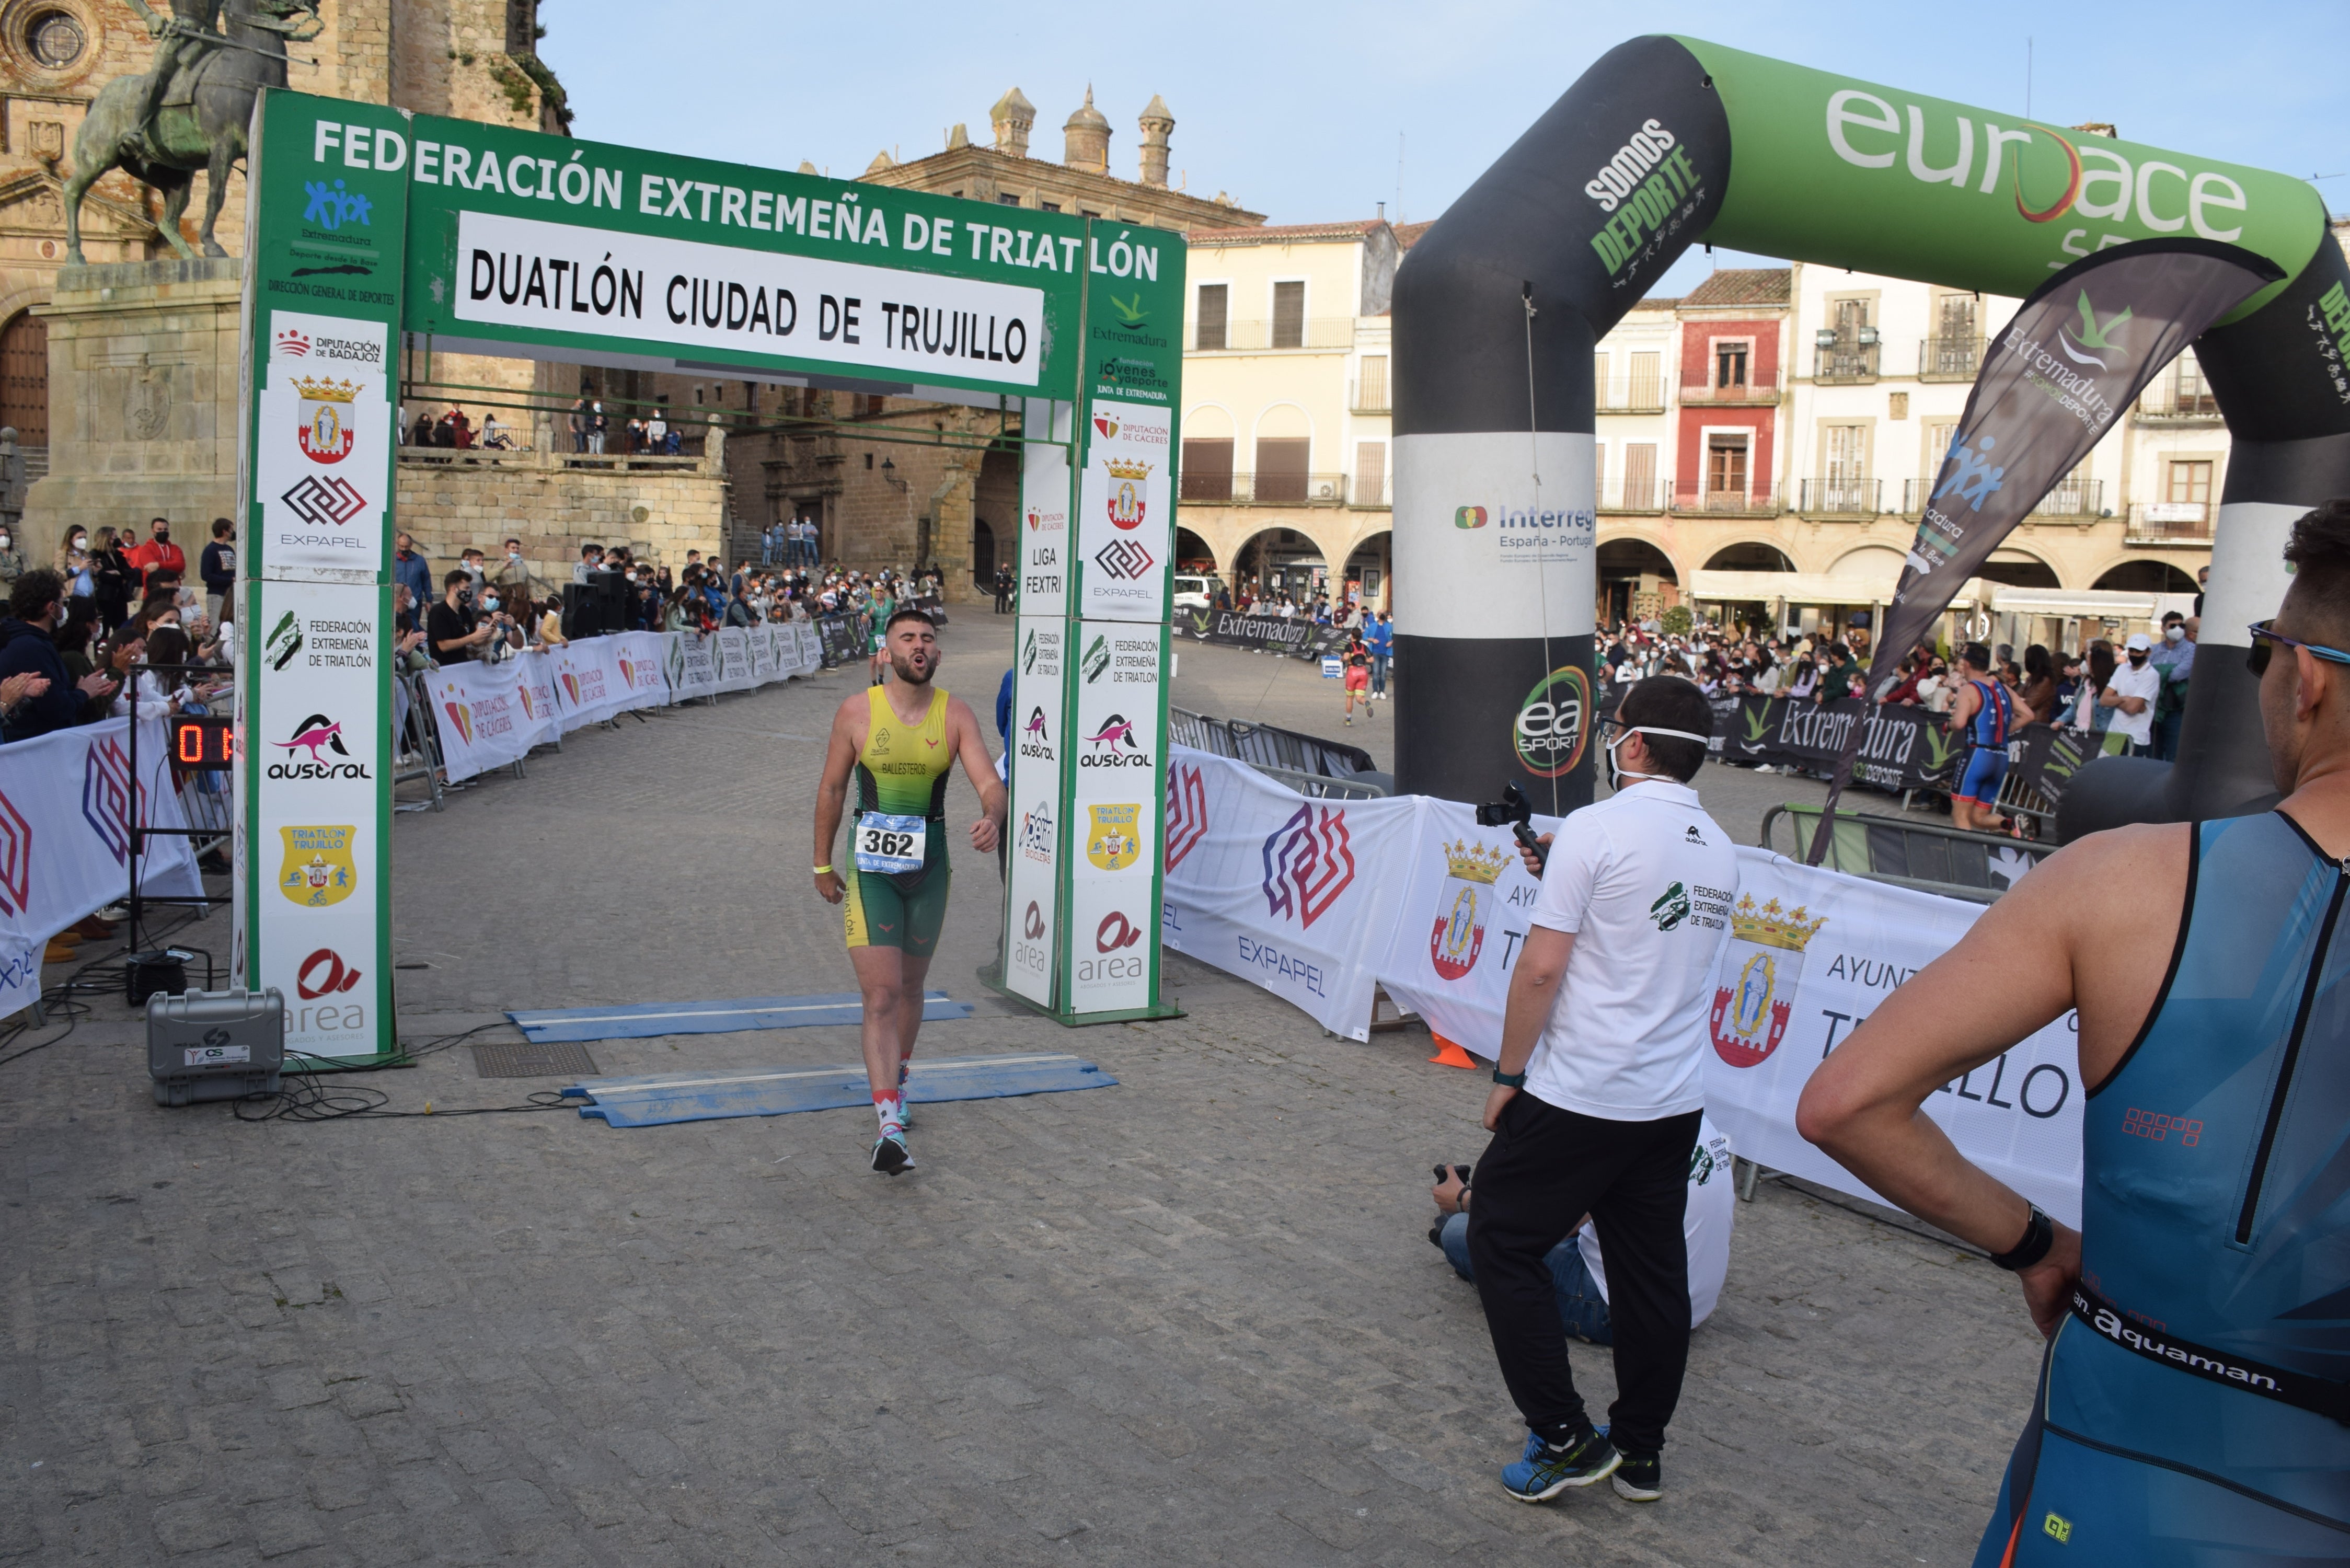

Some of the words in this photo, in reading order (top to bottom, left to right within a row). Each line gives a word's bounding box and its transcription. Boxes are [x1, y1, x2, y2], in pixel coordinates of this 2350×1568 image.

[1584, 118, 1675, 212] SOMOS
[315, 119, 623, 210] FEDERACIÓN
[639, 174, 889, 248] EXTREMEÑA
[902, 213, 954, 256] DE
[965, 223, 1158, 281] TRIATLÓN
[1589, 144, 1701, 276] DEPORTE
[302, 228, 372, 246] Extremadura
[289, 249, 321, 260] Deporte
[324, 254, 347, 263] desde
[350, 256, 358, 264] la
[360, 258, 378, 267] Base
[268, 279, 309, 296] DIRECCIÓN
[312, 285, 345, 300] GENERAL
[348, 289, 356, 301] DE
[359, 290, 395, 305] DEPORTES
[470, 248, 643, 319] DUATLÓN
[666, 274, 797, 337] CIUDAD
[819, 293, 861, 344] DE
[882, 302, 1027, 364] TRUJILLO
[316, 338, 381, 353] DIPUTACIÓN
[1093, 327, 1167, 348] Extremadura
[316, 349, 326, 358] DE
[329, 349, 380, 363] BADAJOZ
[1119, 357, 1154, 367] fundación
[1098, 358, 1156, 378] jóvenes
[2003, 326, 2114, 424] Extremadura
[1097, 385, 1114, 395] JUNTA
[1116, 387, 1123, 396] DE
[1126, 388, 1167, 401] EXTREMADURA
[1123, 423, 1168, 436] DIPUTACIÓN
[1500, 505, 1593, 532] Interreg
[281, 534, 367, 549] EXPAPEL
[1500, 535, 1548, 549] España
[1560, 535, 1593, 548] Portugal
[1033, 548, 1056, 566] LIGA
[1026, 575, 1061, 594] FEXTRI
[1094, 587, 1153, 599] EXPAPEL
[310, 619, 371, 633] FEDERACIÓN
[1217, 613, 1306, 643] Extremadura
[312, 637, 369, 651] EXTREMEÑA
[1038, 632, 1060, 644] FEDERACIÓN
[1115, 639, 1158, 652] FEDERACIÓN
[309, 654, 322, 666] DE
[325, 653, 371, 667] TRIATLÓN
[1039, 648, 1058, 660] EXTREMEÑA
[1116, 655, 1156, 667] EXTREMEÑA
[1038, 664, 1042, 674] DE
[1113, 672, 1123, 683] DE
[1517, 699, 1581, 736] ea
[476, 722, 485, 739] DE
[1778, 699, 1917, 764] Extremdura
[1518, 735, 1579, 752] SPORT
[1021, 743, 1055, 762] austral
[882, 763, 926, 775] BALLESTEROS
[1080, 754, 1153, 768] austral
[267, 764, 373, 779] austral
[1097, 815, 1133, 824] TRUJILLO
[293, 839, 344, 849] TRUJILLO
[864, 830, 914, 857] 362
[1685, 837, 1709, 847] austral
[1025, 848, 1051, 864] BICICLETAS
[873, 859, 880, 867] DE
[881, 860, 919, 870] EXTREMADURA
[1694, 885, 1734, 904] FEDERACIÓN
[844, 887, 856, 936] TRIATLÓN
[1694, 900, 1729, 917] EXTREMEÑA
[1690, 915, 1699, 926] DE
[1016, 941, 1044, 972] area
[1078, 957, 1142, 981] area
[1238, 935, 1326, 998] EXPAPEL
[327, 1033, 364, 1042] ASESORES
